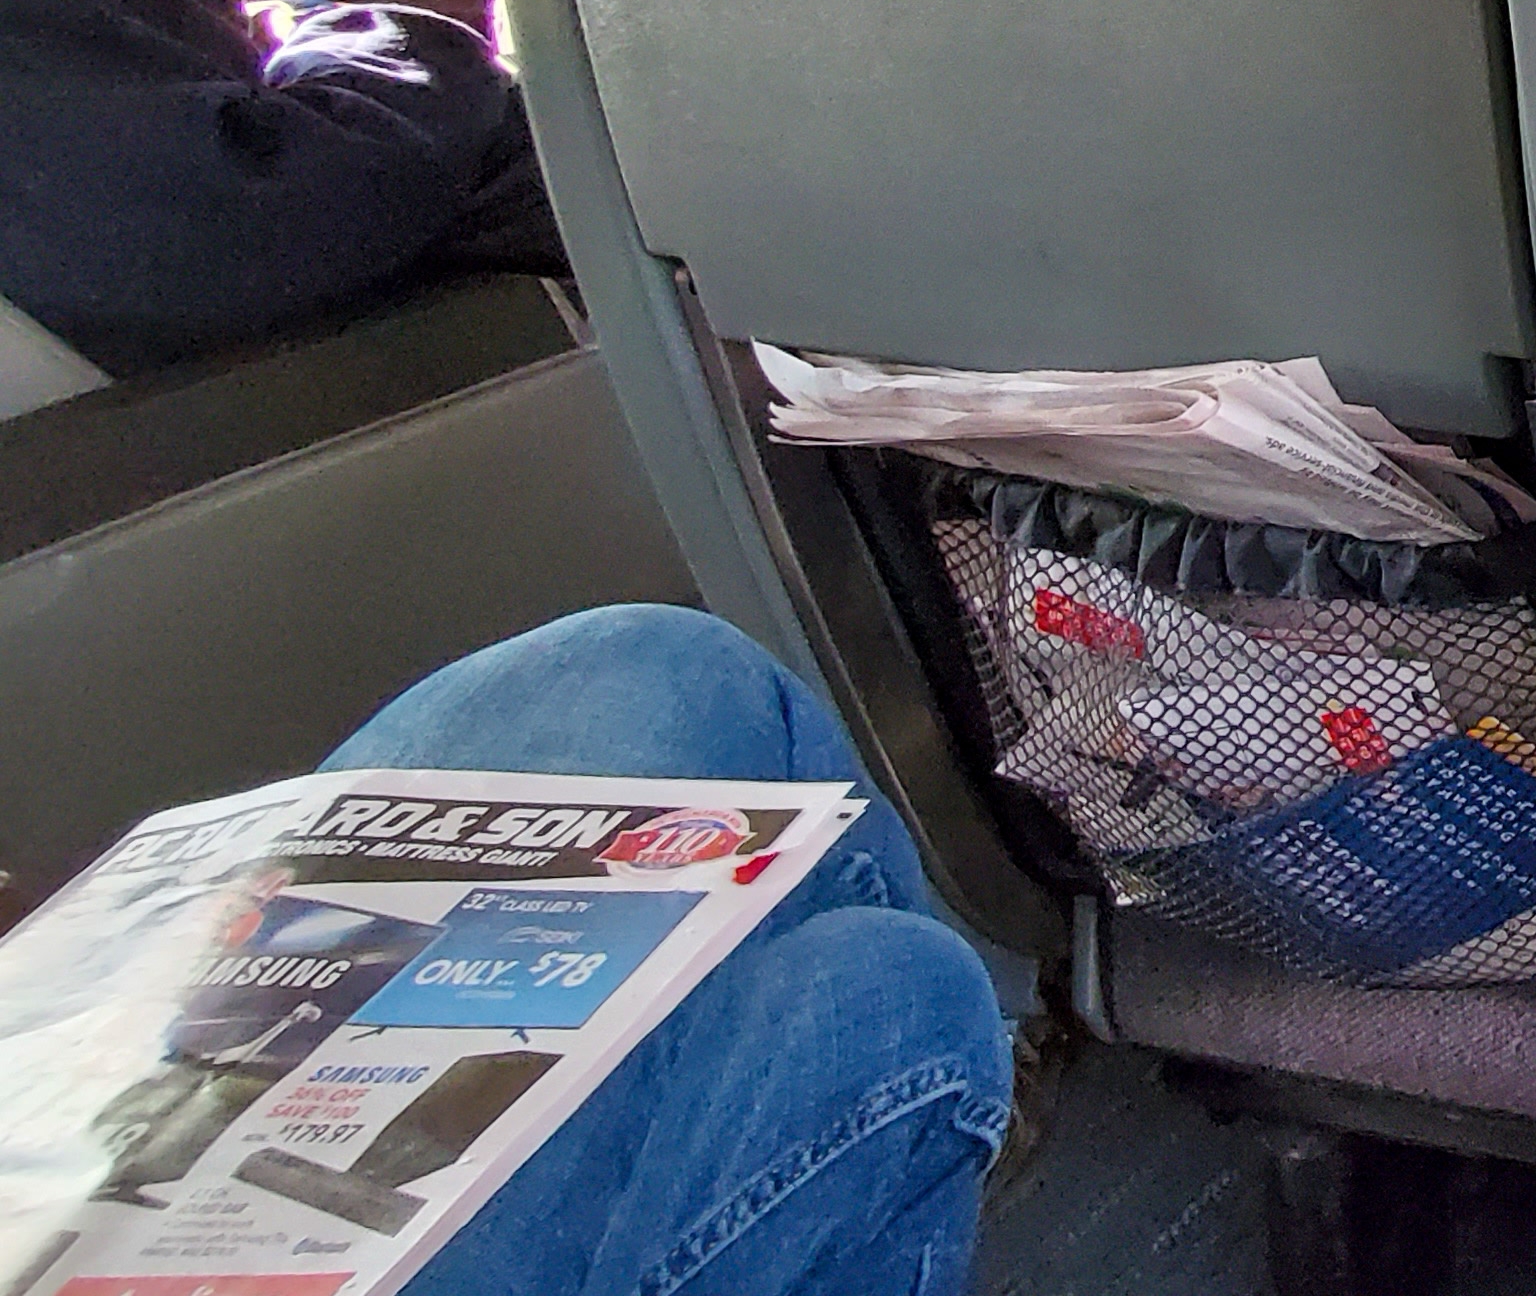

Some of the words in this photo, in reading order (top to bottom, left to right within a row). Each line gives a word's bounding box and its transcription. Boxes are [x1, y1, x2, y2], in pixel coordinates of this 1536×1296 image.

[463, 807, 632, 849] SON
[364, 840, 484, 863] MATTRESS
[637, 826, 721, 855] 110
[188, 955, 351, 990] AMSUNG
[414, 958, 520, 986] ONLY
[528, 950, 608, 988] $78
[307, 1065, 430, 1085] SAMSUNG
[329, 1088, 372, 1102] OFF
[265, 1104, 319, 1119] SAVE
[279, 1123, 367, 1144] $179.97
